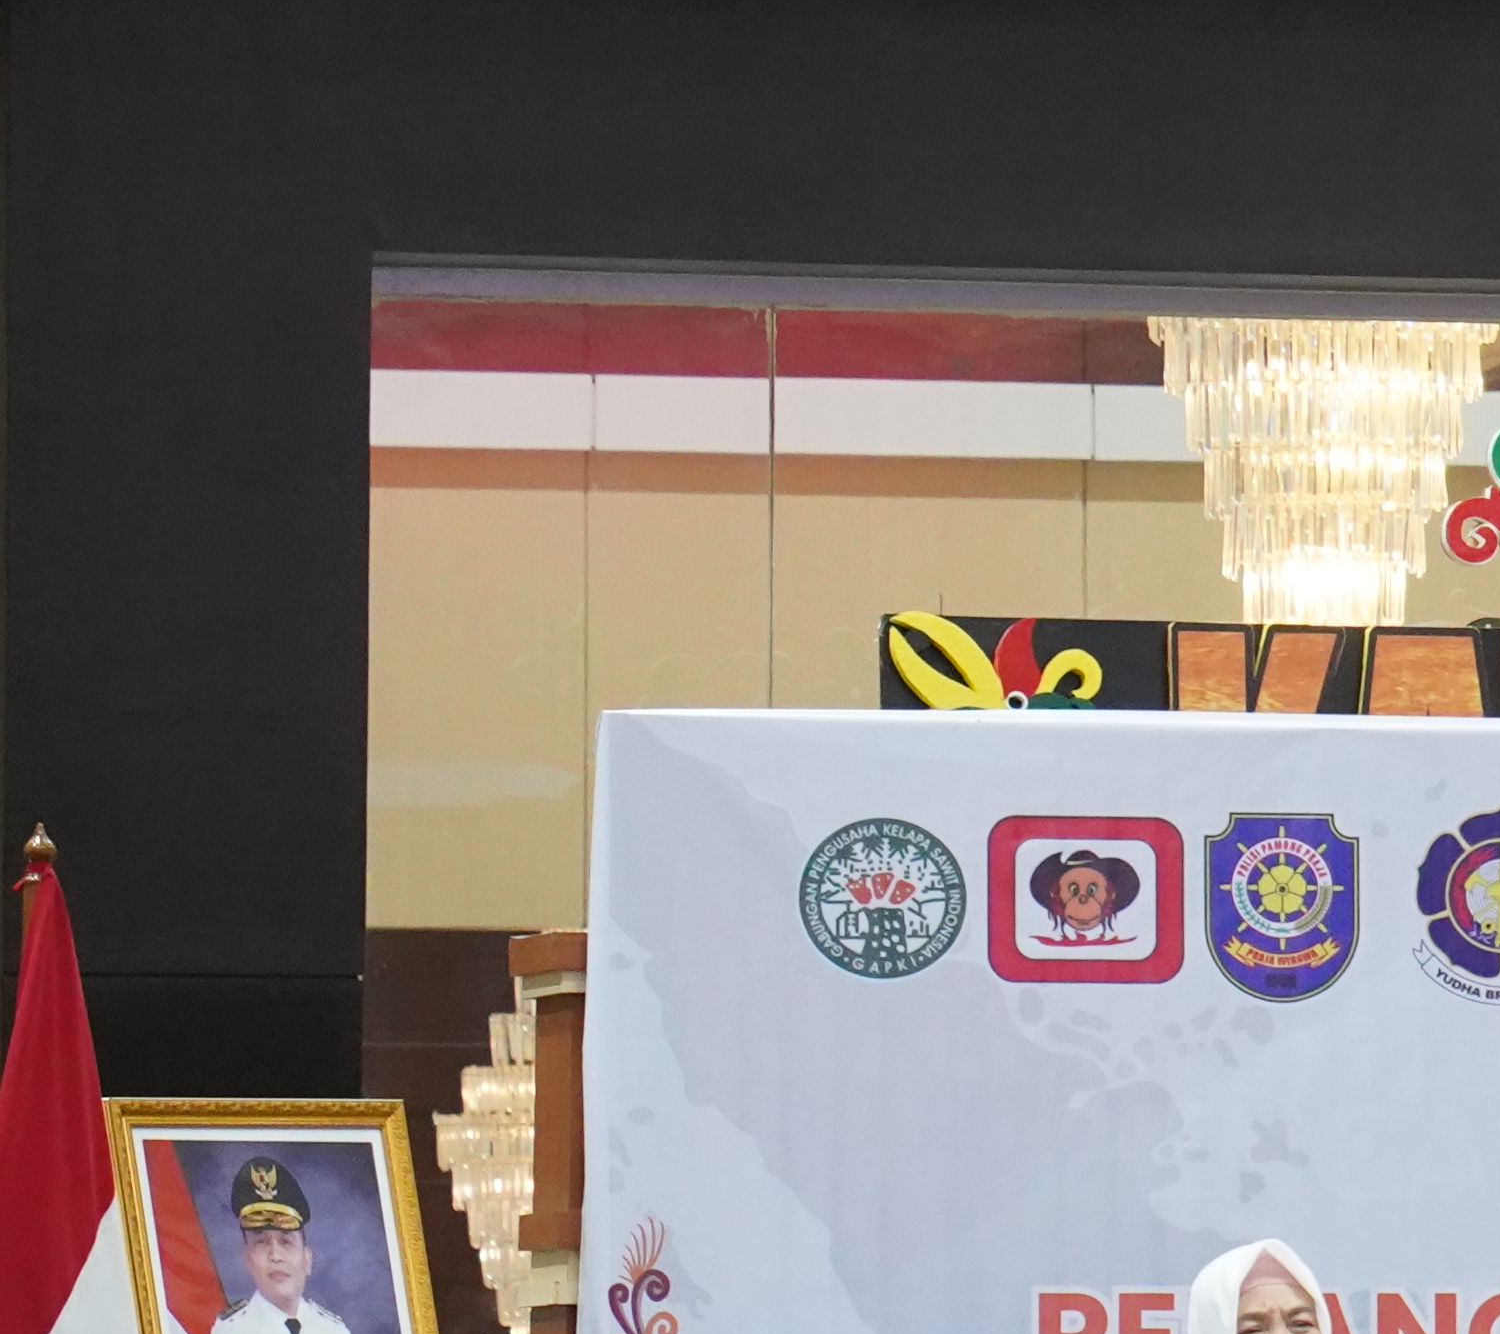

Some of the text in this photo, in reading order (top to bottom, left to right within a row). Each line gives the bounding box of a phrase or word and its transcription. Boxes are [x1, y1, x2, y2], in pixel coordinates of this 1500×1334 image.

[805, 823, 962, 959] GABUNGAN PENGUSAHA KELAPA SAWIT INDONESIA
[852, 955, 918, 974] GAPKI
[1435, 967, 1481, 998] YUDHA
